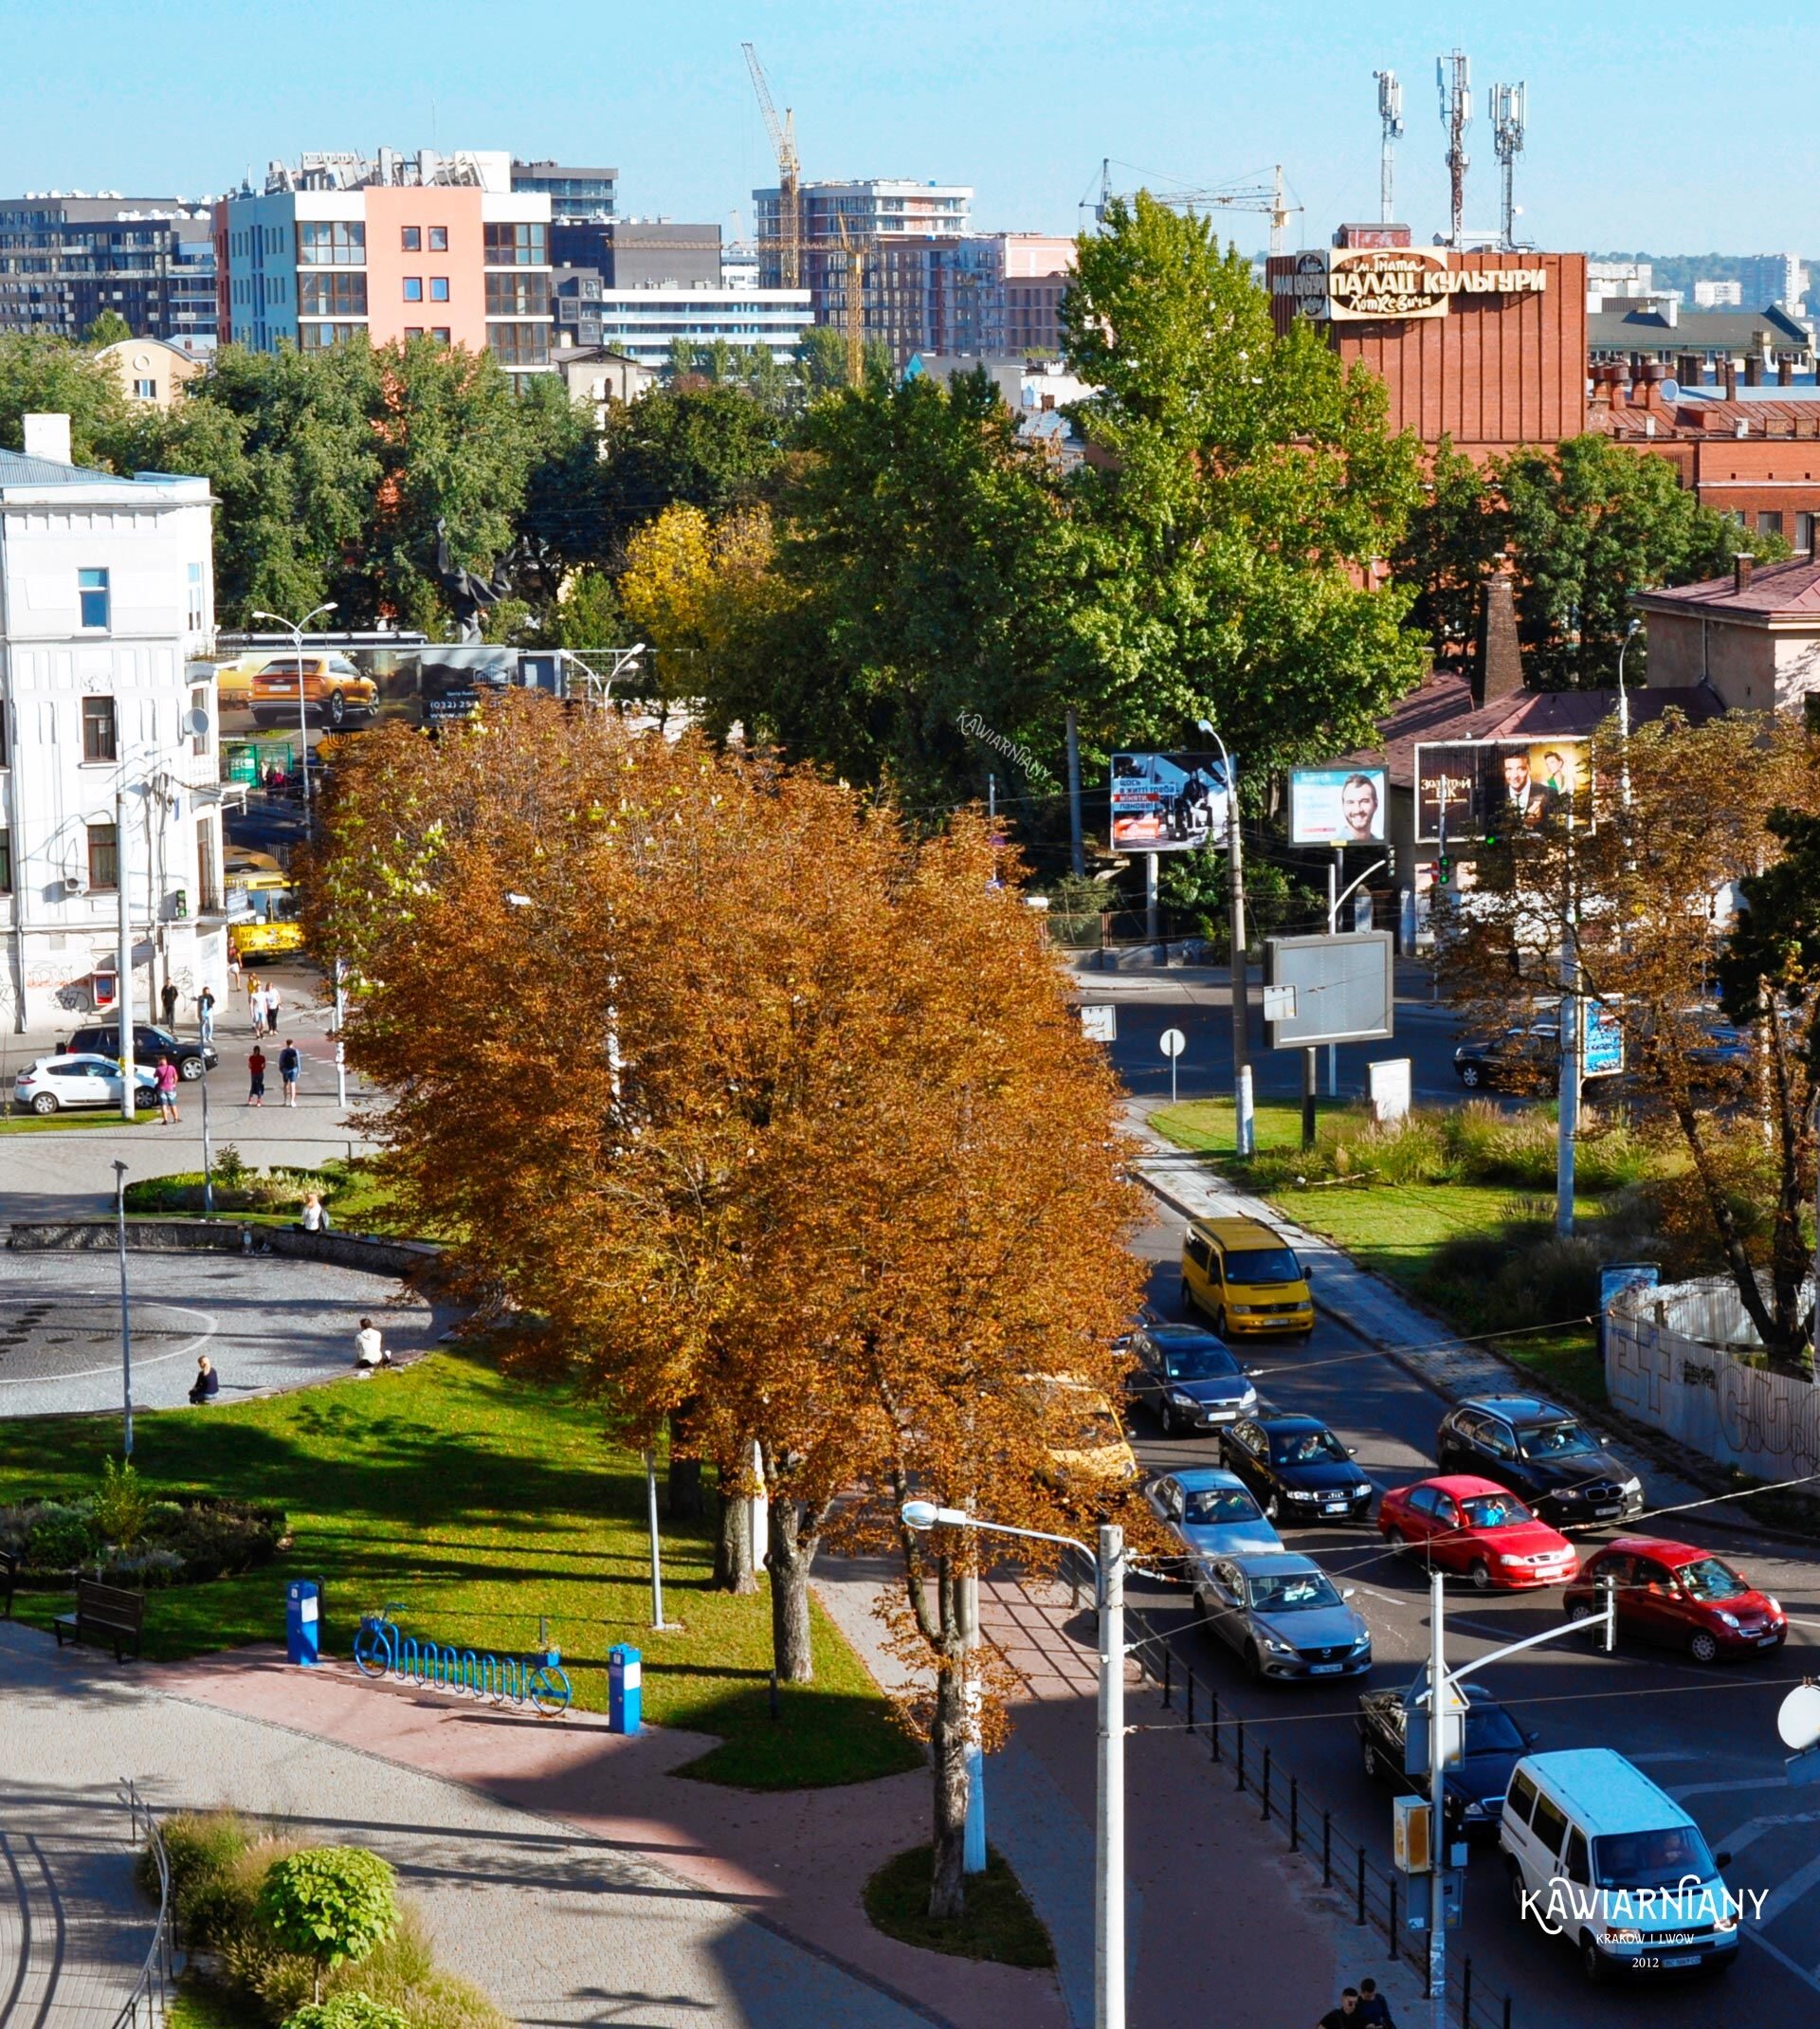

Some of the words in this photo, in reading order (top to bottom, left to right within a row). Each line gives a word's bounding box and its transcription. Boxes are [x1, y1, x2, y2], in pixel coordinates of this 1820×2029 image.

[1373, 253, 1425, 273] Гната
[1329, 271, 1417, 296] ПАЛАЦ
[1424, 269, 1547, 293] КУЛЬТУРИ
[1349, 294, 1431, 314] Хоткевича
[429, 700, 456, 709] (032)
